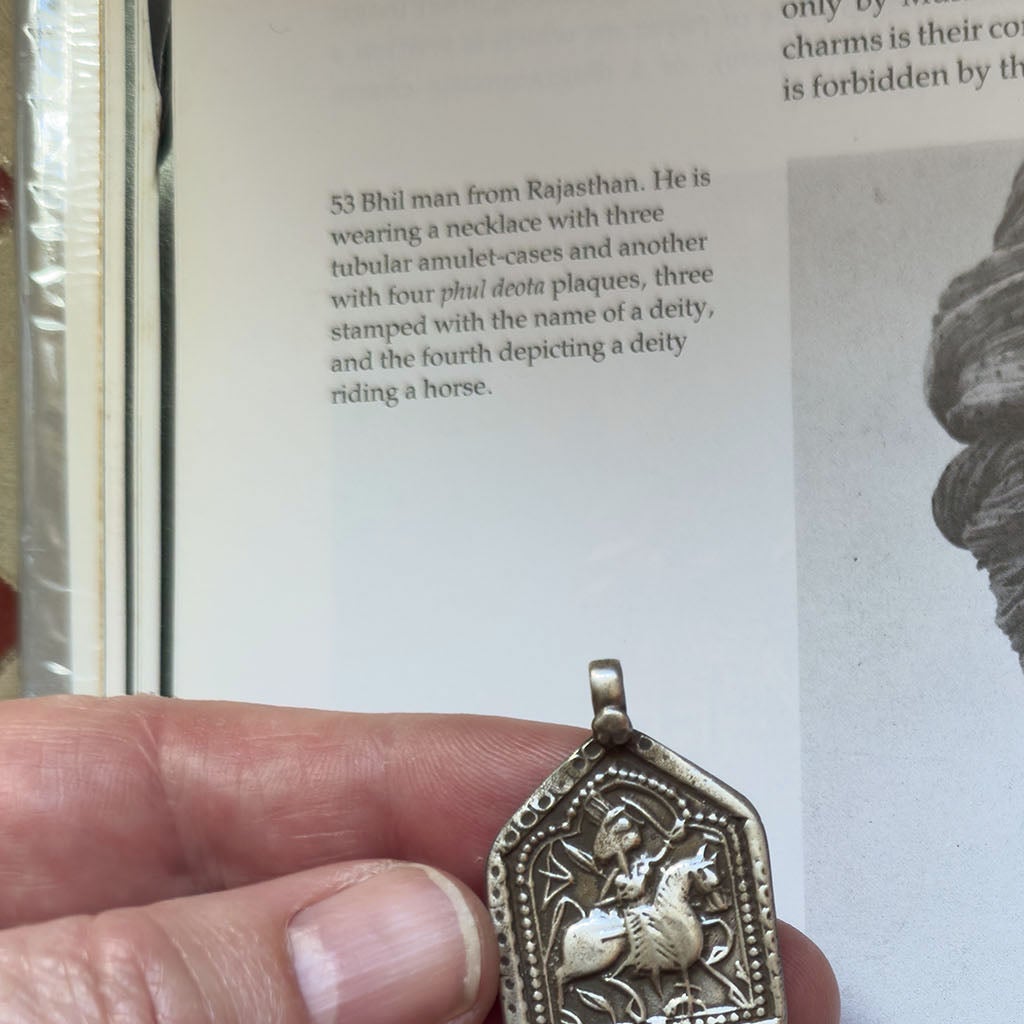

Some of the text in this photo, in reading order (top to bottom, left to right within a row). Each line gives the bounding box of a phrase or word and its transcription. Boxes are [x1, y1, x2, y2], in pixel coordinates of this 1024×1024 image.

[781, 0, 885, 23] only by
[782, 33, 882, 59] charms
[889, 26, 911, 49] is
[918, 19, 982, 46] their
[783, 78, 804, 101] is
[812, 64, 949, 98] forbidden
[956, 58, 991, 91] by
[330, 168, 711, 215] 53 Bhil man from Rajasthan. He is
[330, 204, 664, 247] wearing a necklace with three
[330, 232, 708, 277] tubular amulet-cases and another
[329, 265, 713, 309] with four phul deota plaques, three
[330, 298, 714, 344] stamped with the name of a deity,
[330, 332, 687, 372] and the fourth depicting a deity
[331, 378, 492, 408] riding a horse.
